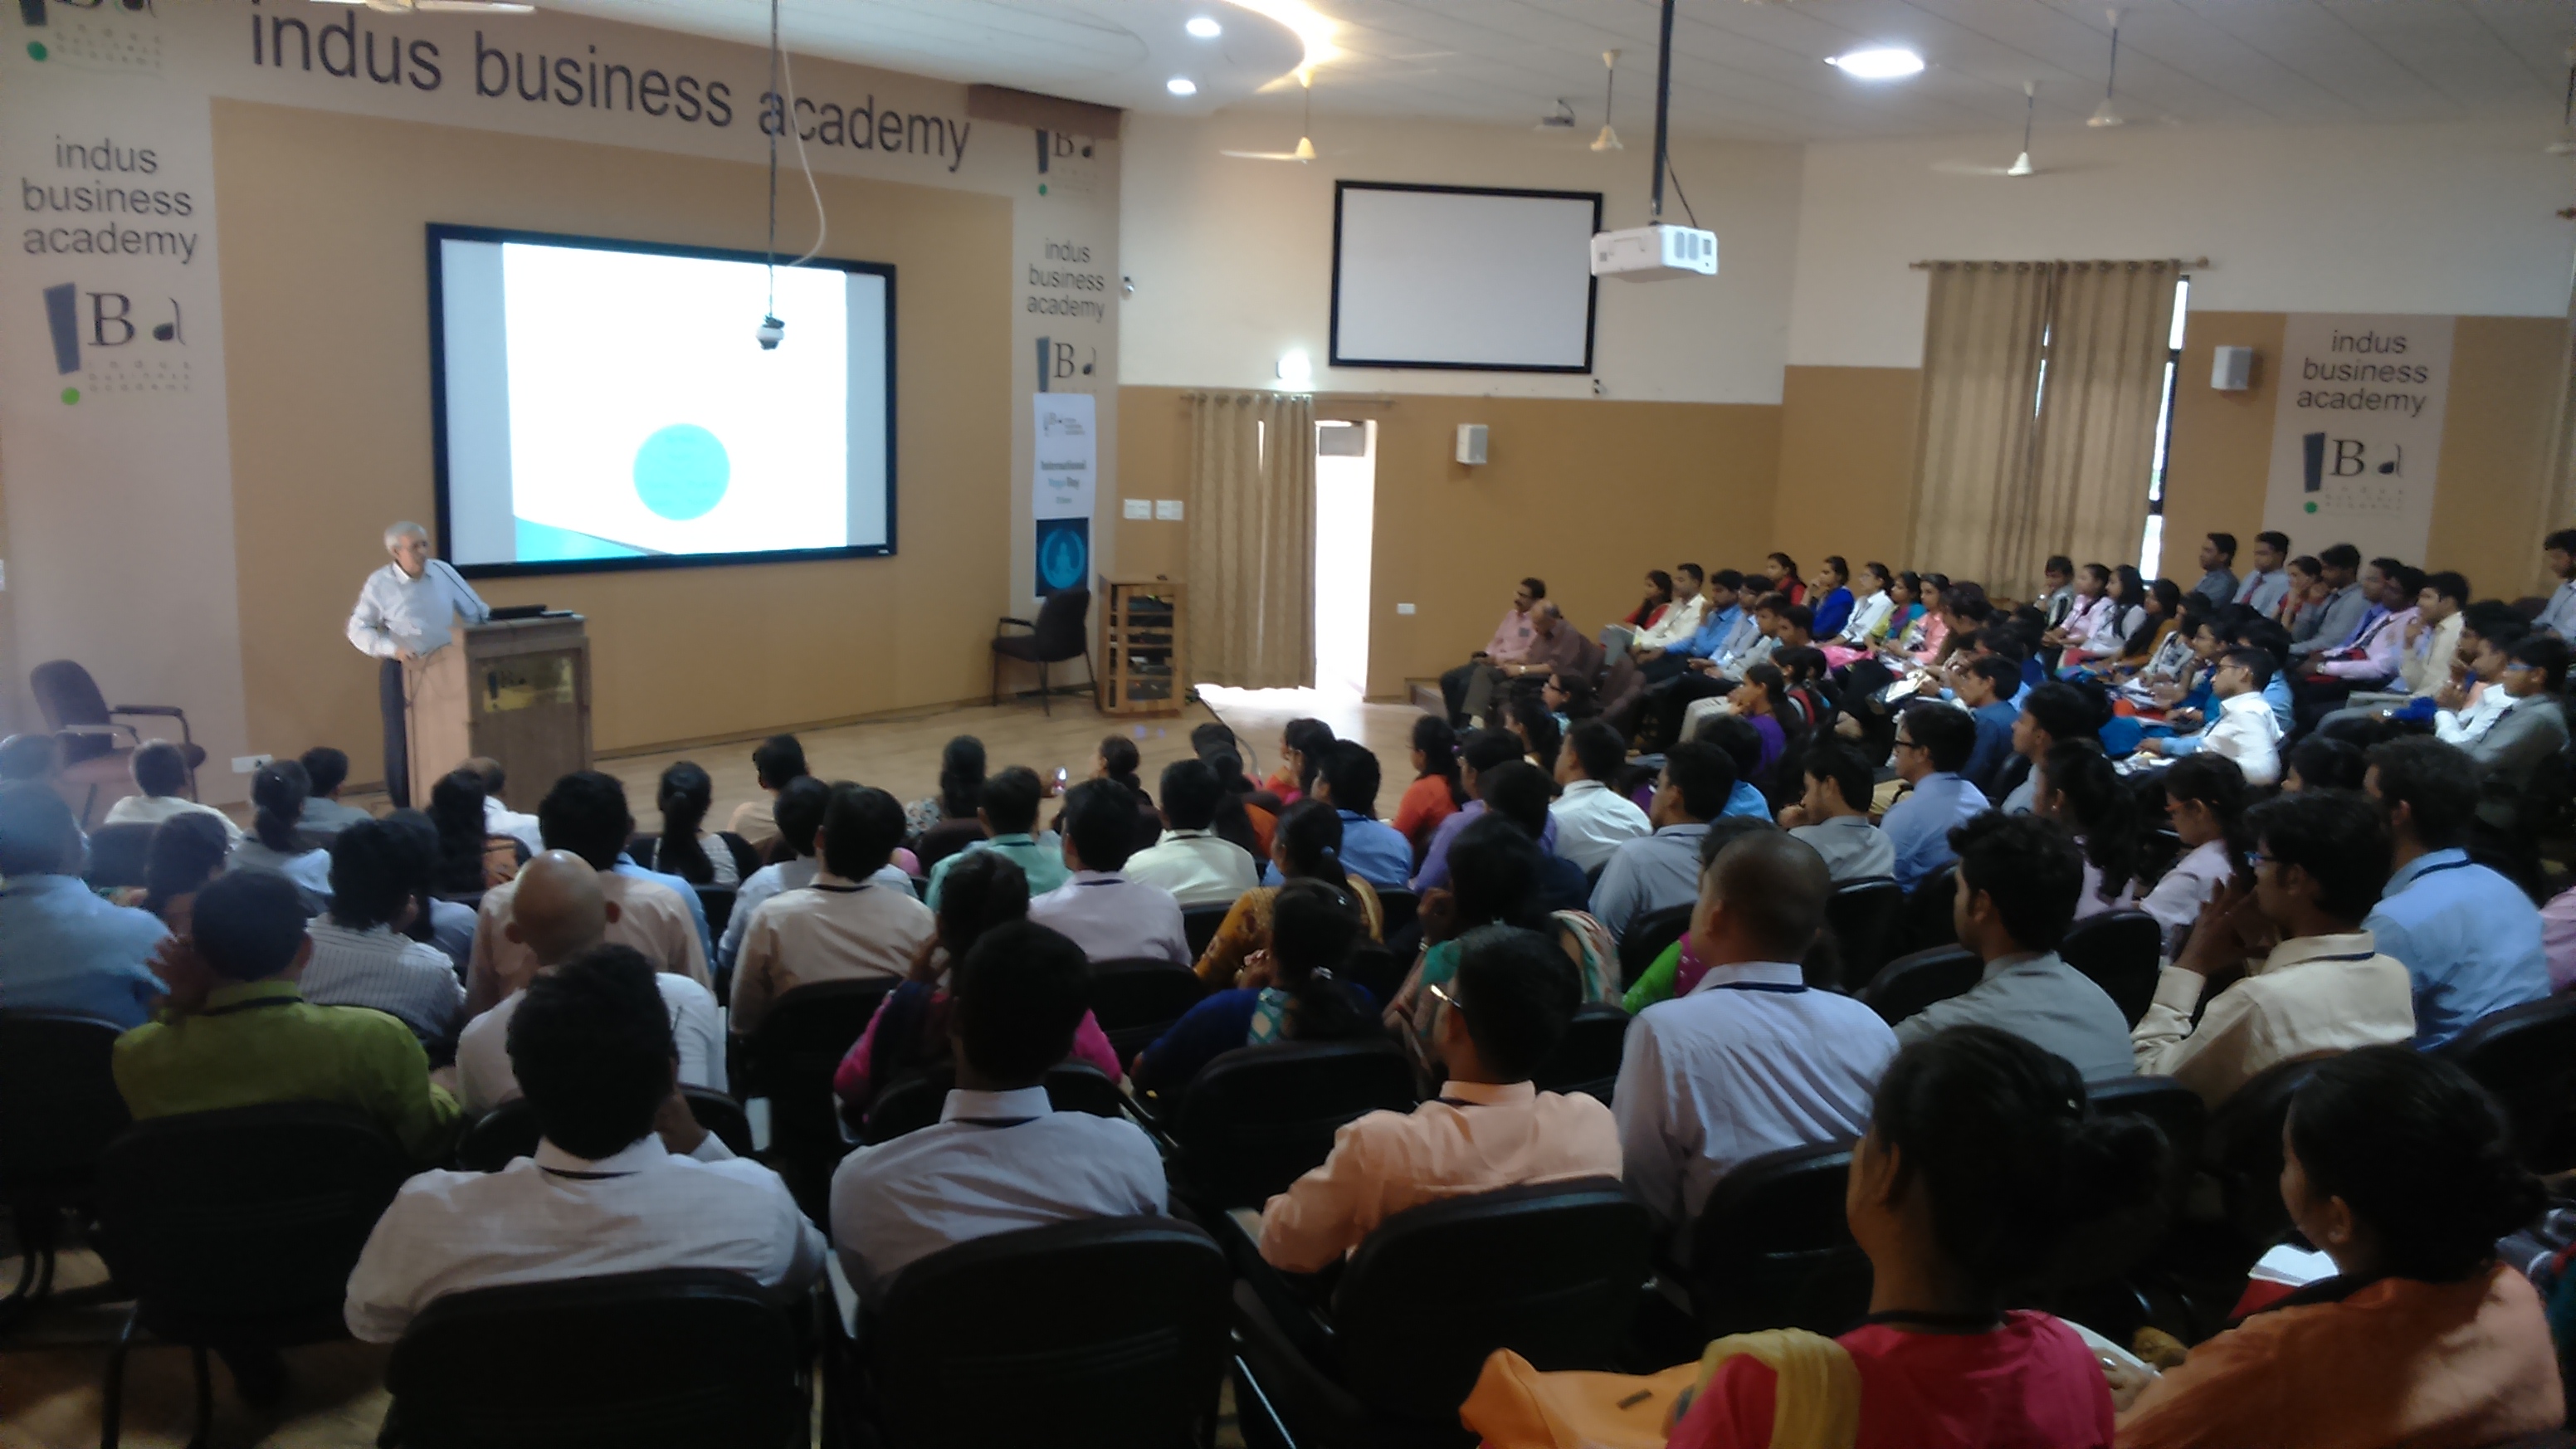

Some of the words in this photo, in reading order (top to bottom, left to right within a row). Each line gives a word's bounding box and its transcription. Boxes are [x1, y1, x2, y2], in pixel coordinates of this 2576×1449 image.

[251, 0, 442, 91] indus
[474, 30, 734, 128] business
[758, 90, 971, 173] academy
[55, 134, 159, 174] indus
[22, 177, 193, 217] business
[22, 222, 198, 265] academy
[1044, 237, 1090, 263] indus
[1029, 263, 1105, 292] business
[1027, 294, 1105, 324] academy
[2331, 329, 2408, 354] indus
[2302, 357, 2429, 384] business
[2296, 388, 2427, 417] academy
